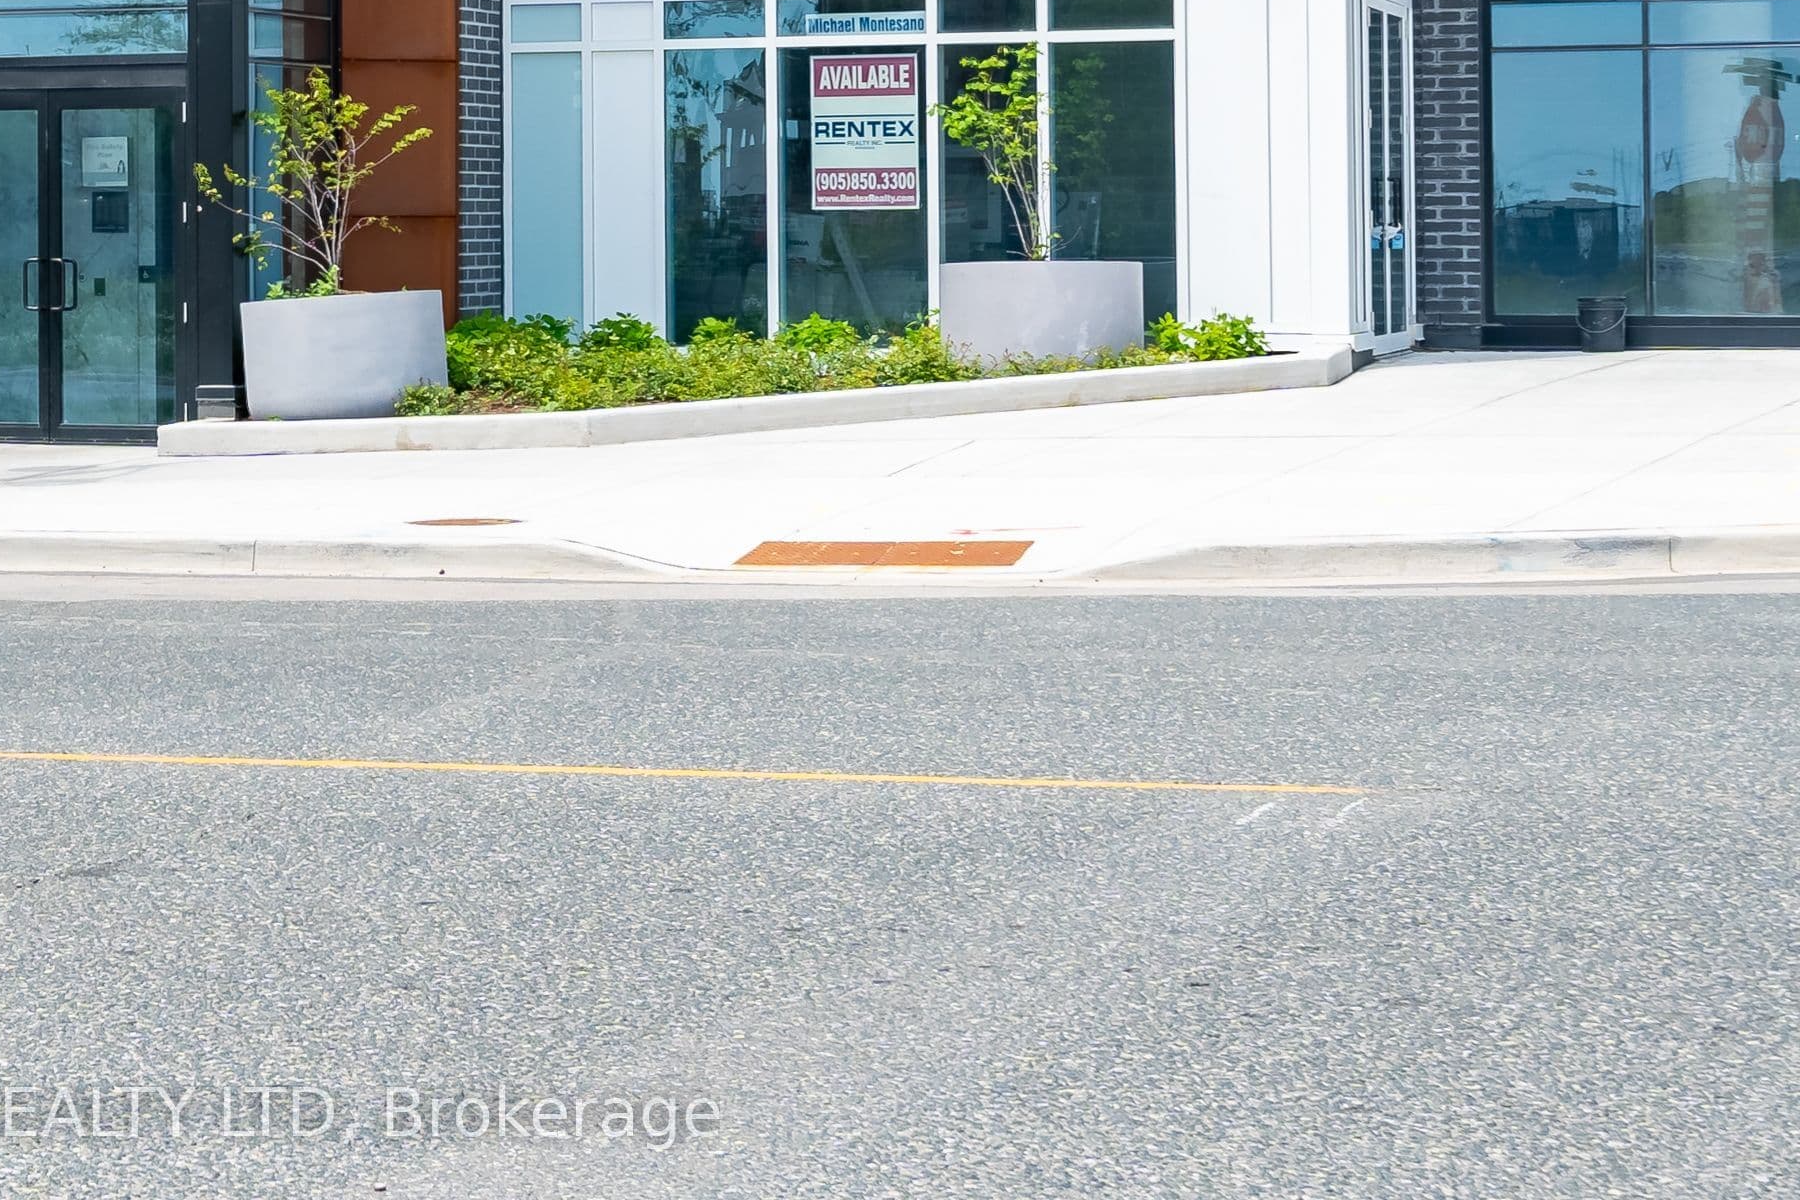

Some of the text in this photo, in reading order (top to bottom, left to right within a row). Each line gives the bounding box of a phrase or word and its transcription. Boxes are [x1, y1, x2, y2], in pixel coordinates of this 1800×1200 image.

[808, 15, 925, 34] Michael Montesano
[819, 63, 911, 91] AVAILABLE
[814, 119, 915, 139] RENTEX
[815, 171, 916, 191] (905)850.3300
